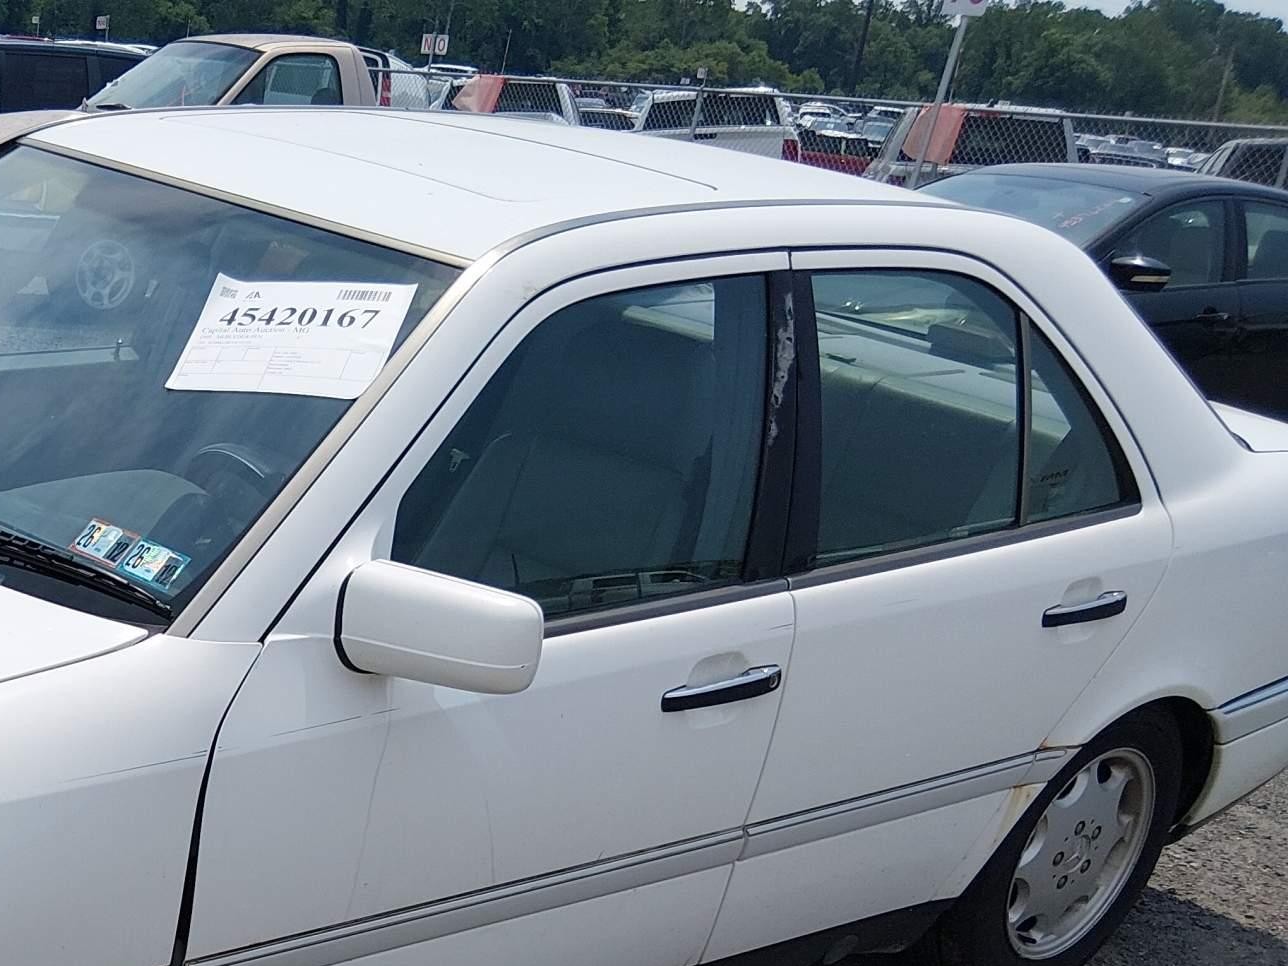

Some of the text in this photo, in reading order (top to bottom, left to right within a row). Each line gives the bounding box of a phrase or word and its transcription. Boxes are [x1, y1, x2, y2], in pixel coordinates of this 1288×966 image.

[219, 307, 380, 328] 45420167
[77, 524, 101, 548] 26
[125, 544, 151, 569] 26
